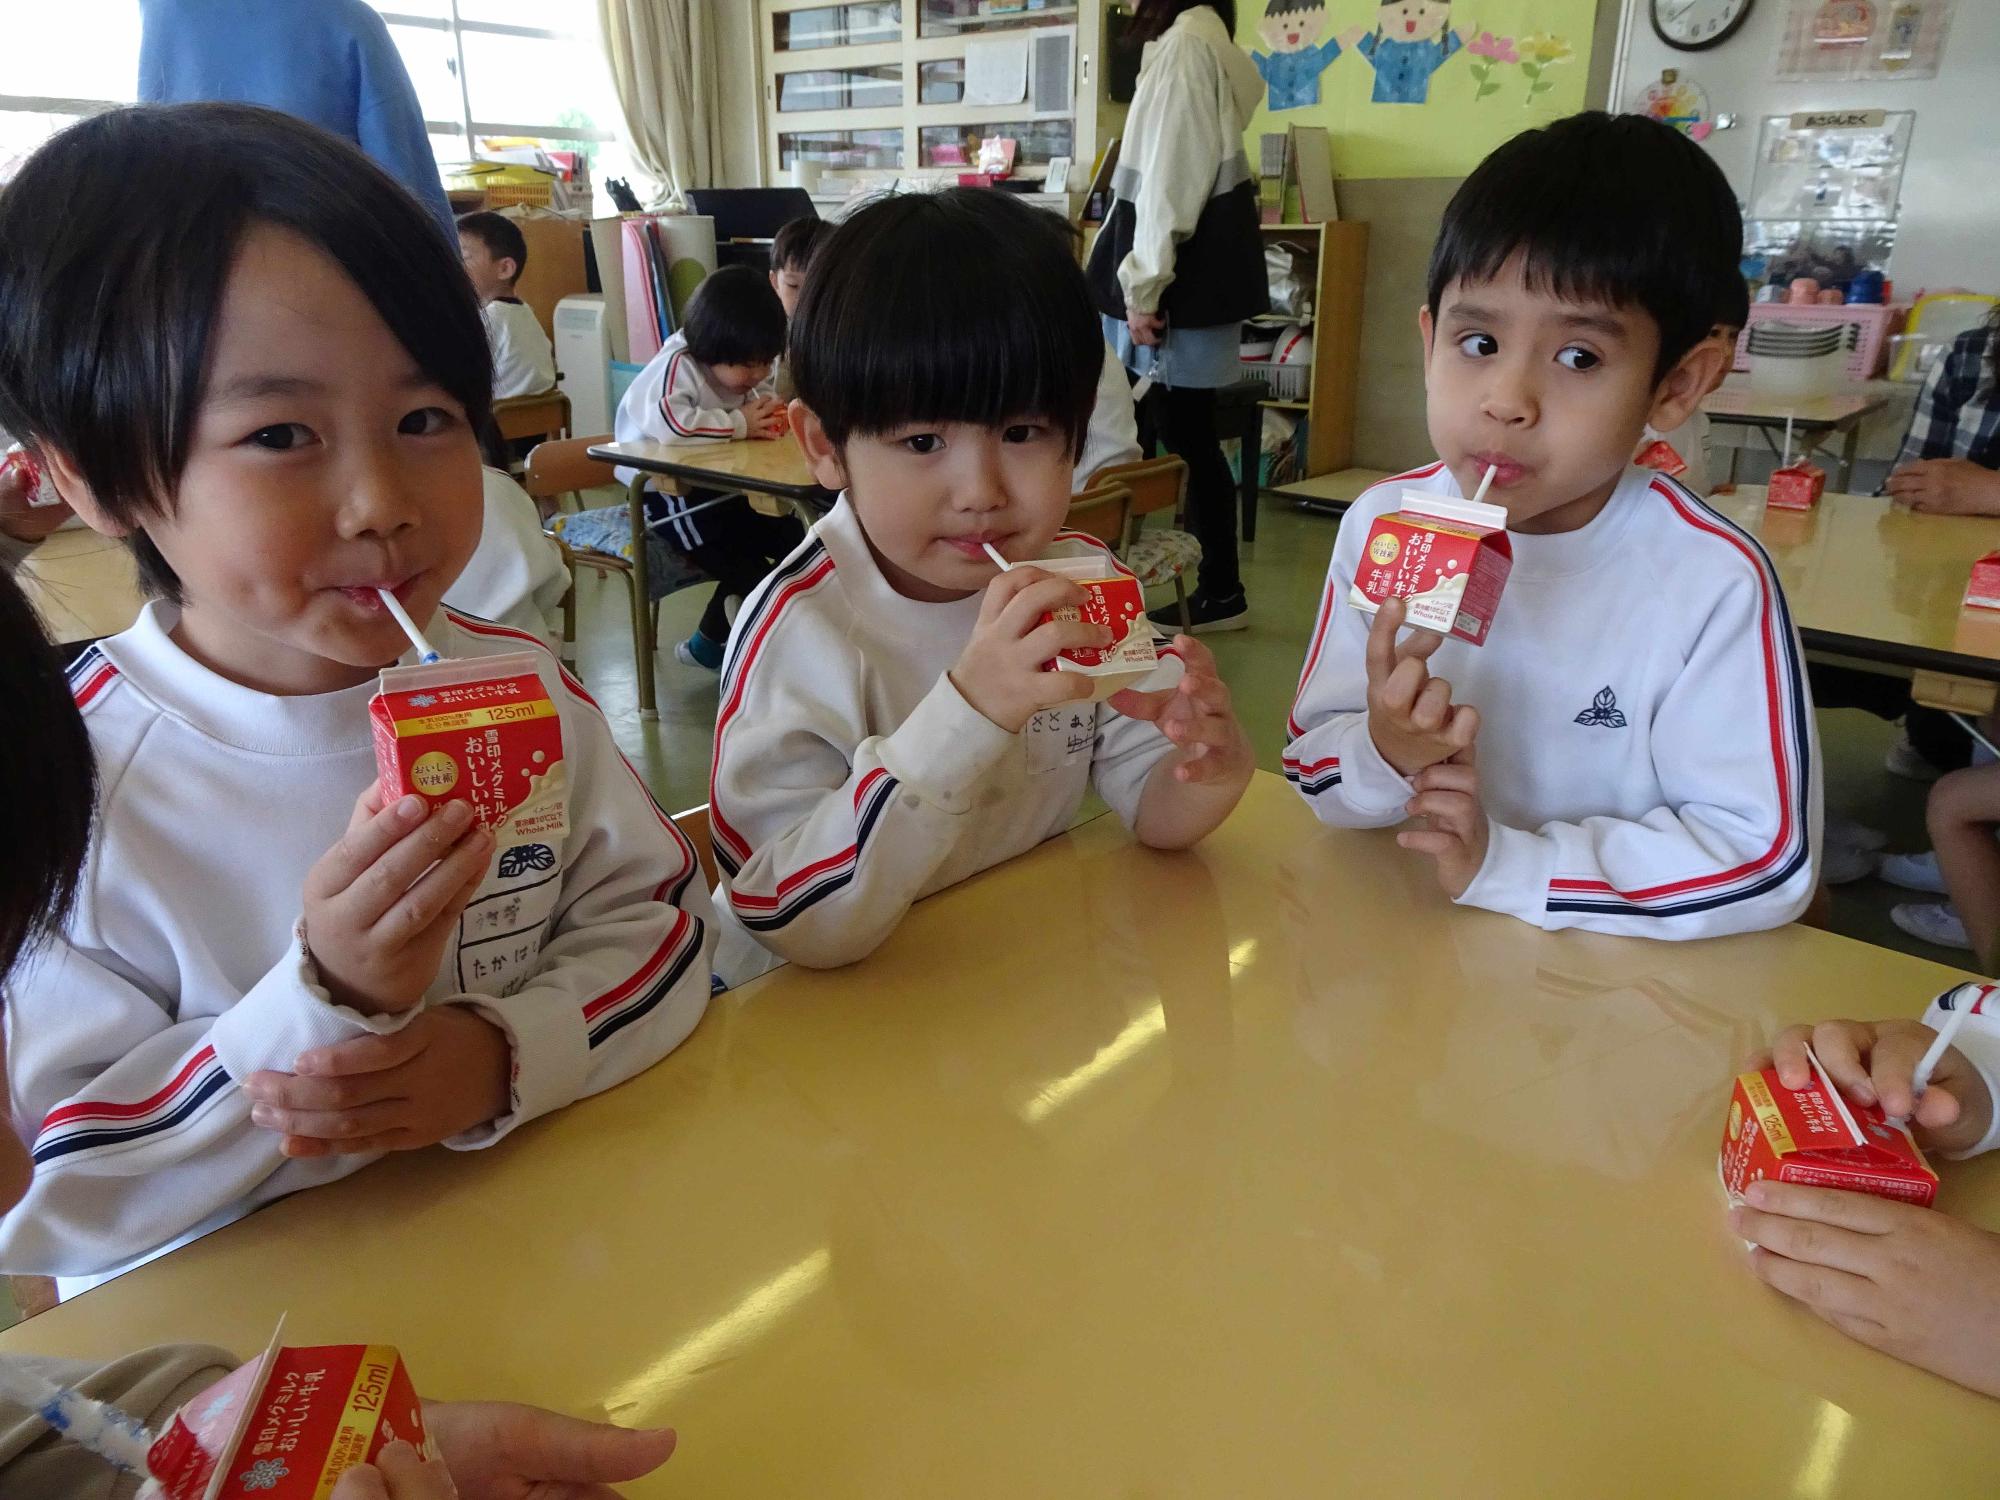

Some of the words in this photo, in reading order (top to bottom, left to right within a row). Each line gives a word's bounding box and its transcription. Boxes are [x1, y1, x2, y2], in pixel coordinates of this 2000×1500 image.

[1391, 533, 1423, 598] おいしい牛
[1405, 533, 1436, 603] 雪印メグミルク
[1366, 569, 1383, 595] 牛乳
[438, 682, 518, 699] 雪印メグミルク
[442, 688, 521, 704] おいしい牛乳
[487, 705, 536, 722] 125ml
[415, 760, 455, 775] おいしさ
[418, 773, 454, 787] W技術
[484, 729, 512, 832] 雪印メグミルク
[515, 825, 546, 836] Whole
[546, 822, 565, 833] Milk
[1763, 1113, 1787, 1142] 125ml
[353, 1363, 390, 1413] 125ml
[252, 1372, 301, 1456] 雪印メグミルク
[278, 1369, 327, 1453] おいしい牛乳
